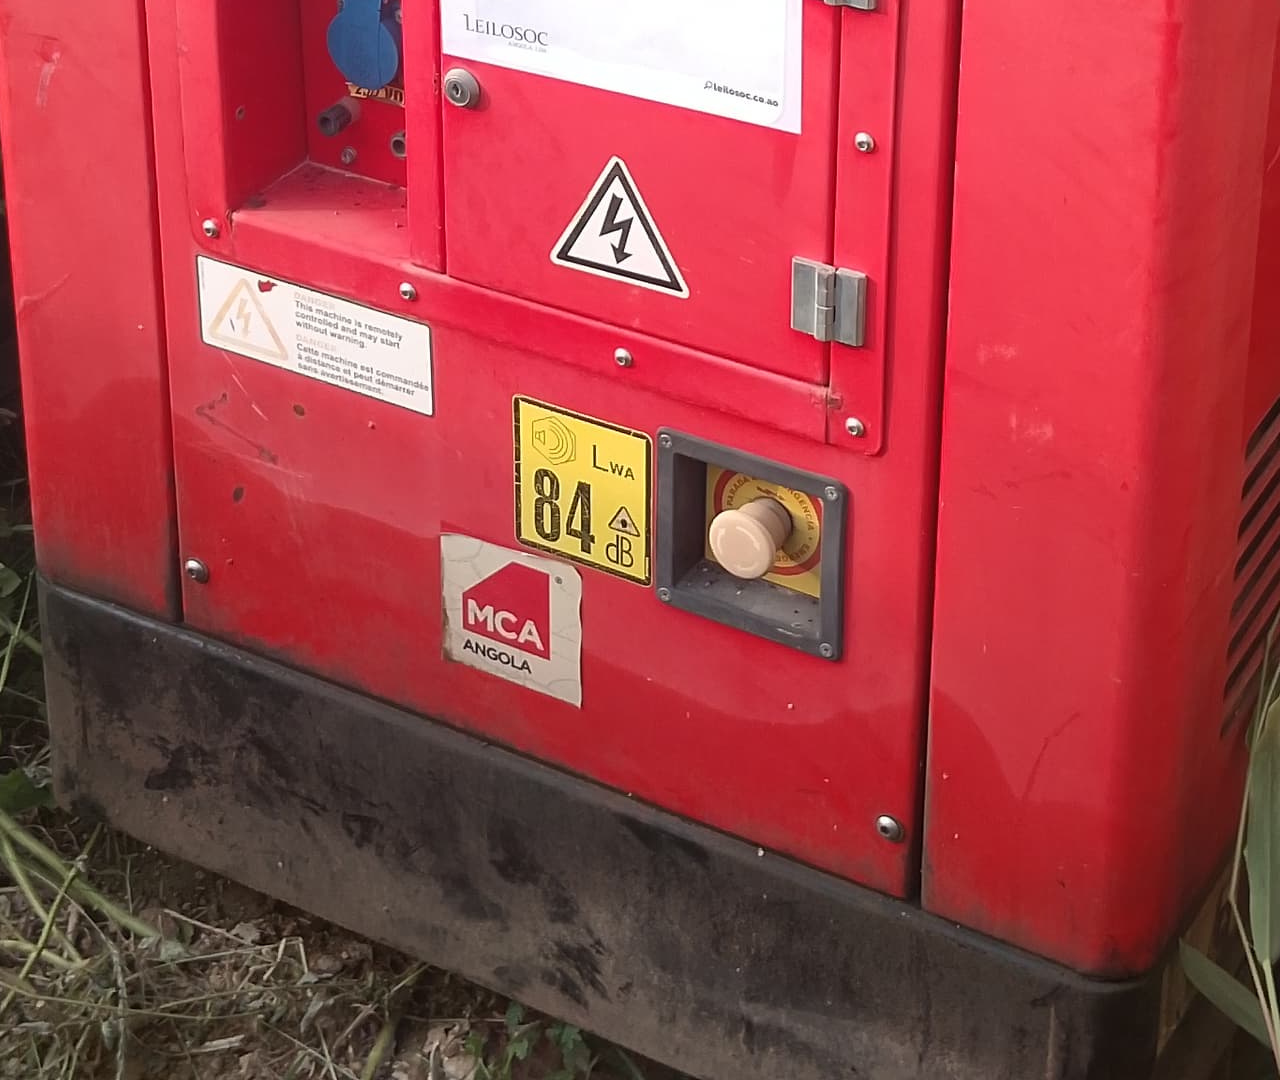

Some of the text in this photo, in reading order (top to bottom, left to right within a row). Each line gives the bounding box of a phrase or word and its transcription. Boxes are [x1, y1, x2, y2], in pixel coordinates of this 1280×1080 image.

[295, 300, 402, 341] This machine is remotely
[295, 311, 400, 349] controlled and may start
[296, 321, 328, 336] without
[297, 343, 319, 356] Cette
[321, 352, 358, 369] machine
[360, 364, 373, 374] est
[298, 362, 318, 374] sans
[305, 355, 340, 372] distance
[343, 367, 352, 376] et
[354, 371, 373, 383] peut
[533, 469, 634, 568] 84 dB
[467, 598, 545, 651] MCA
[462, 638, 532, 675] ANGOLA
